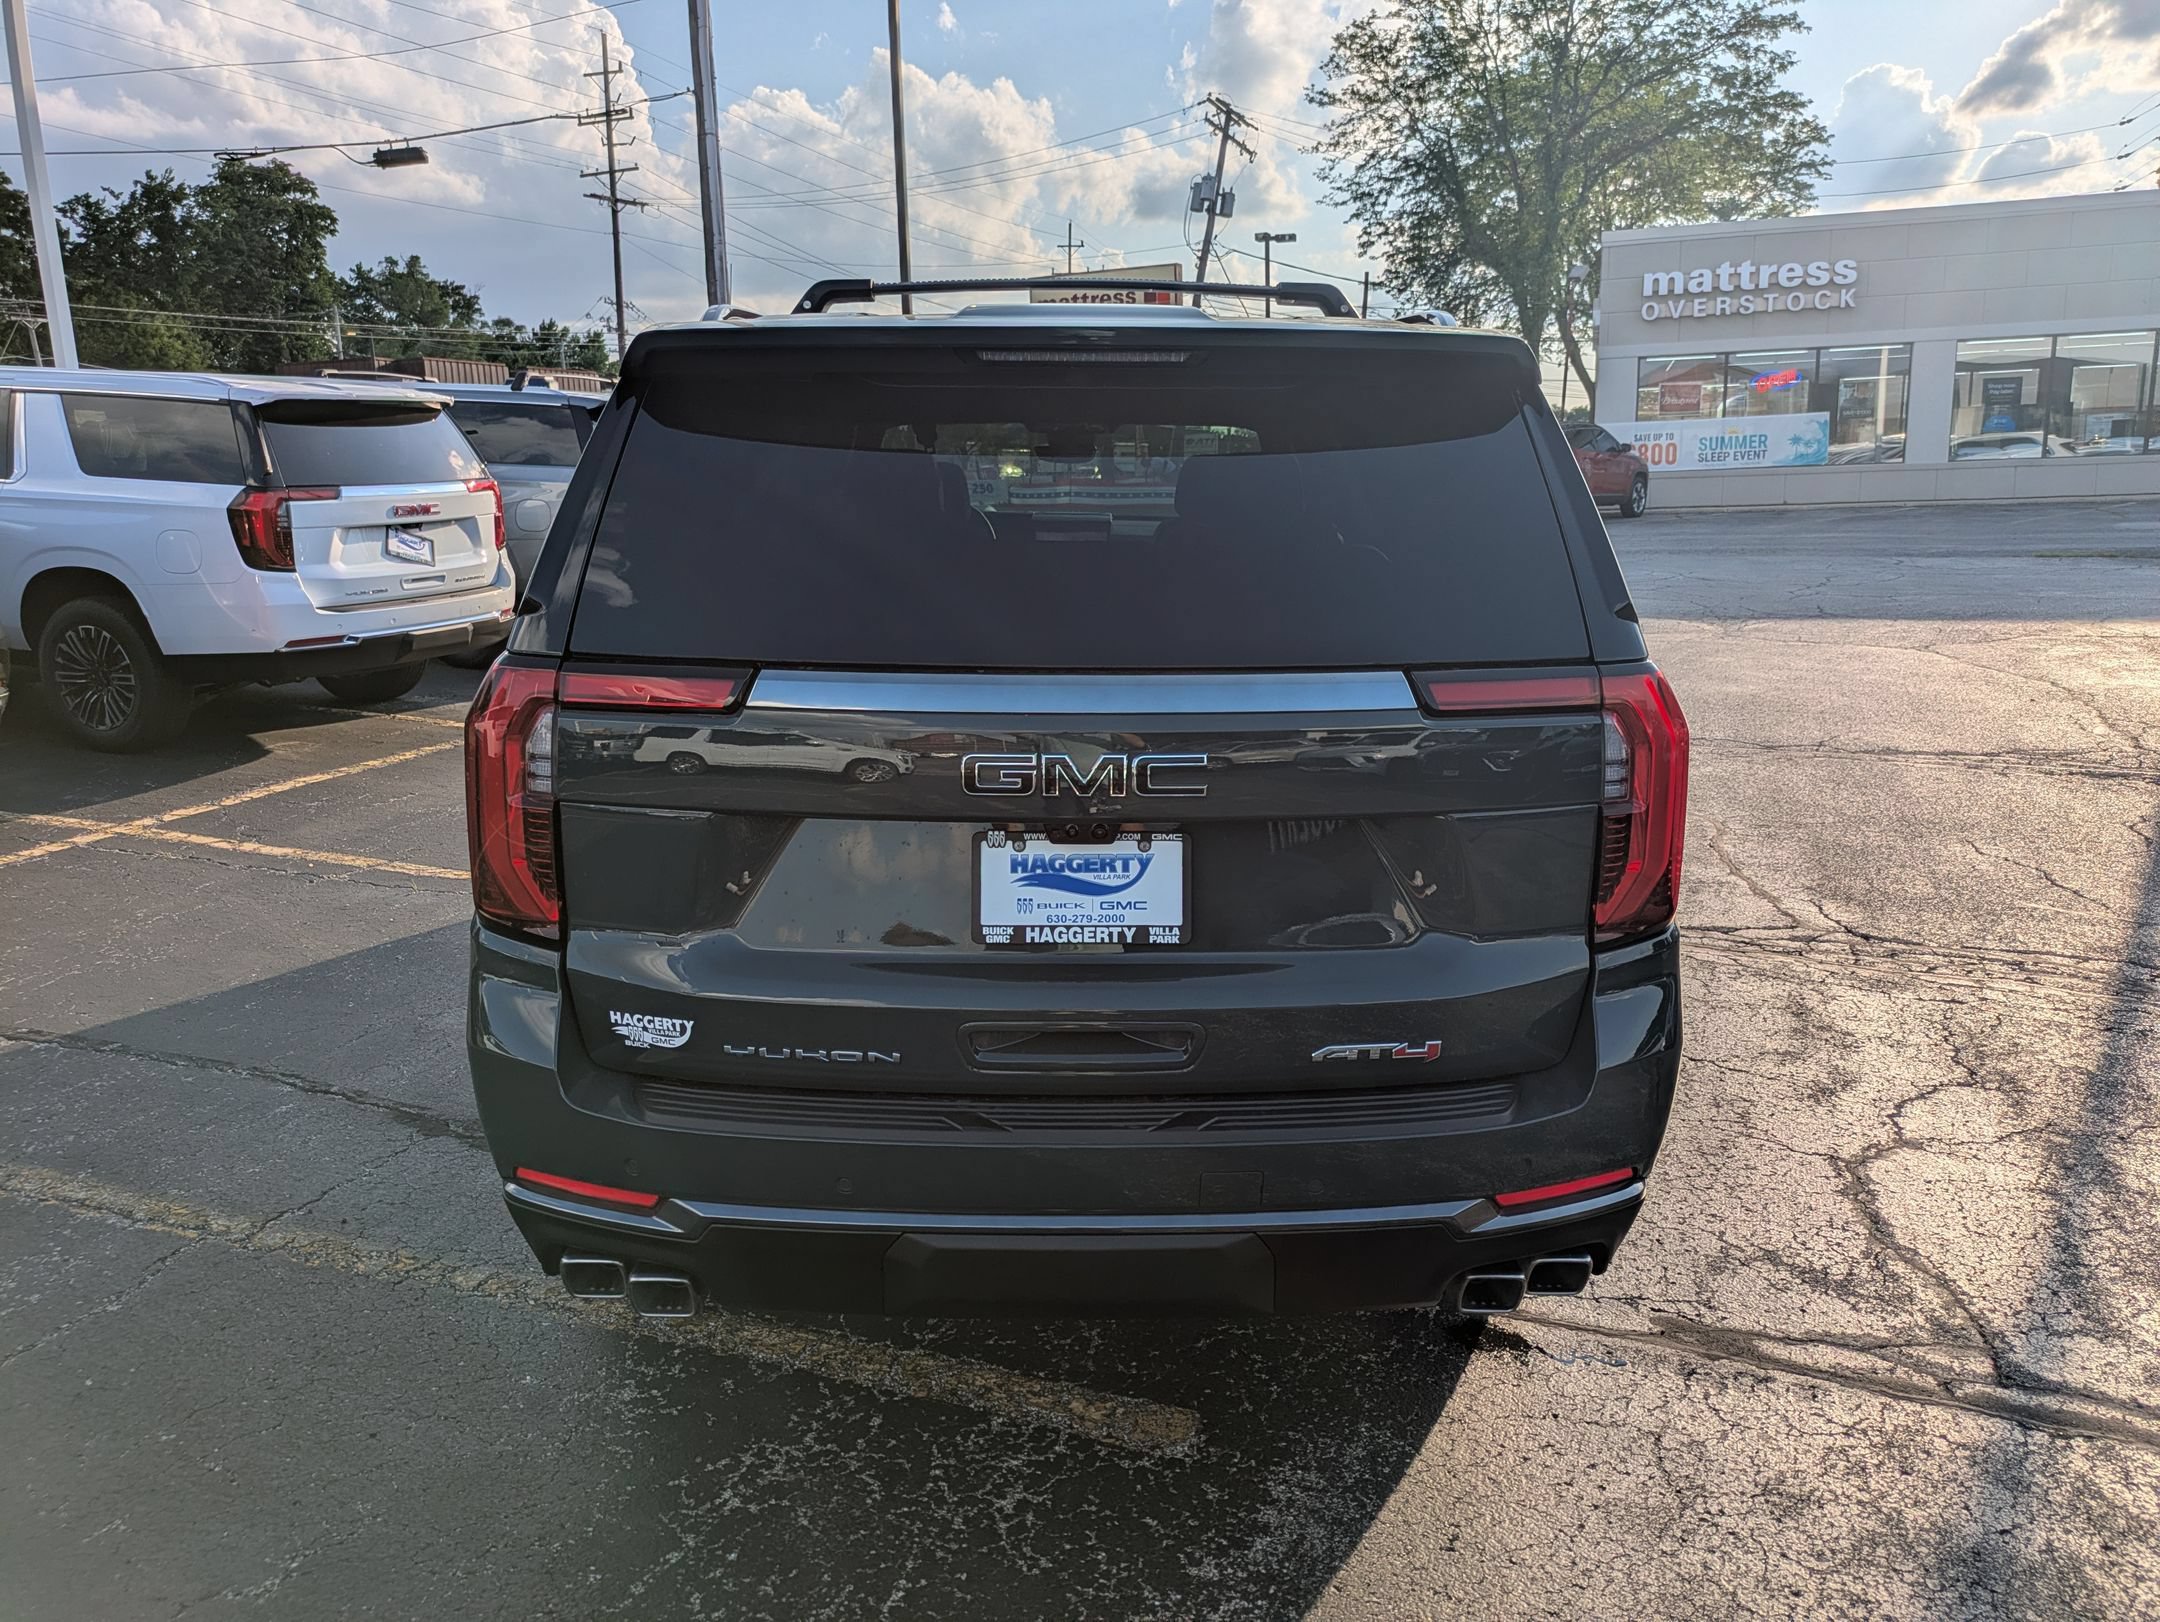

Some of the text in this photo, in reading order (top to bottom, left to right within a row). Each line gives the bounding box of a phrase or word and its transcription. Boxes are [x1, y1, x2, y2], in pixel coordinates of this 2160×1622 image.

[1642, 258, 1858, 297] mattress
[1641, 288, 1857, 321] OVERSTOCK
[1756, 367, 1798, 394] OPEN
[1633, 432, 1675, 442] SAVE UP TO
[1698, 434, 1768, 452] SUMMER
[1697, 449, 1768, 463] SLEEP EVENT
[392, 503, 441, 518] GMC
[960, 753, 1209, 797] GMC
[1151, 833, 1183, 841] GMC
[1009, 853, 1156, 874] HAGGERTY
[1112, 873, 1132, 881] PARK
[1036, 901, 1148, 911] BUICK GMC
[1046, 913, 1126, 924] 630-279-2000
[982, 926, 1014, 936] BUICK
[1025, 926, 1137, 944] HAGGERTY
[1148, 926, 1180, 936] VILLA
[985, 935, 1011, 944] GMC
[1149, 935, 1180, 944] PARK
[609, 1010, 695, 1033] HAGGERTY
[647, 1028, 681, 1038] VILLA PARK
[624, 1039, 651, 1049] BUICK
[651, 1036, 677, 1046] GMC
[723, 1045, 901, 1063] YUKON
[1311, 1040, 1443, 1064] AT4
